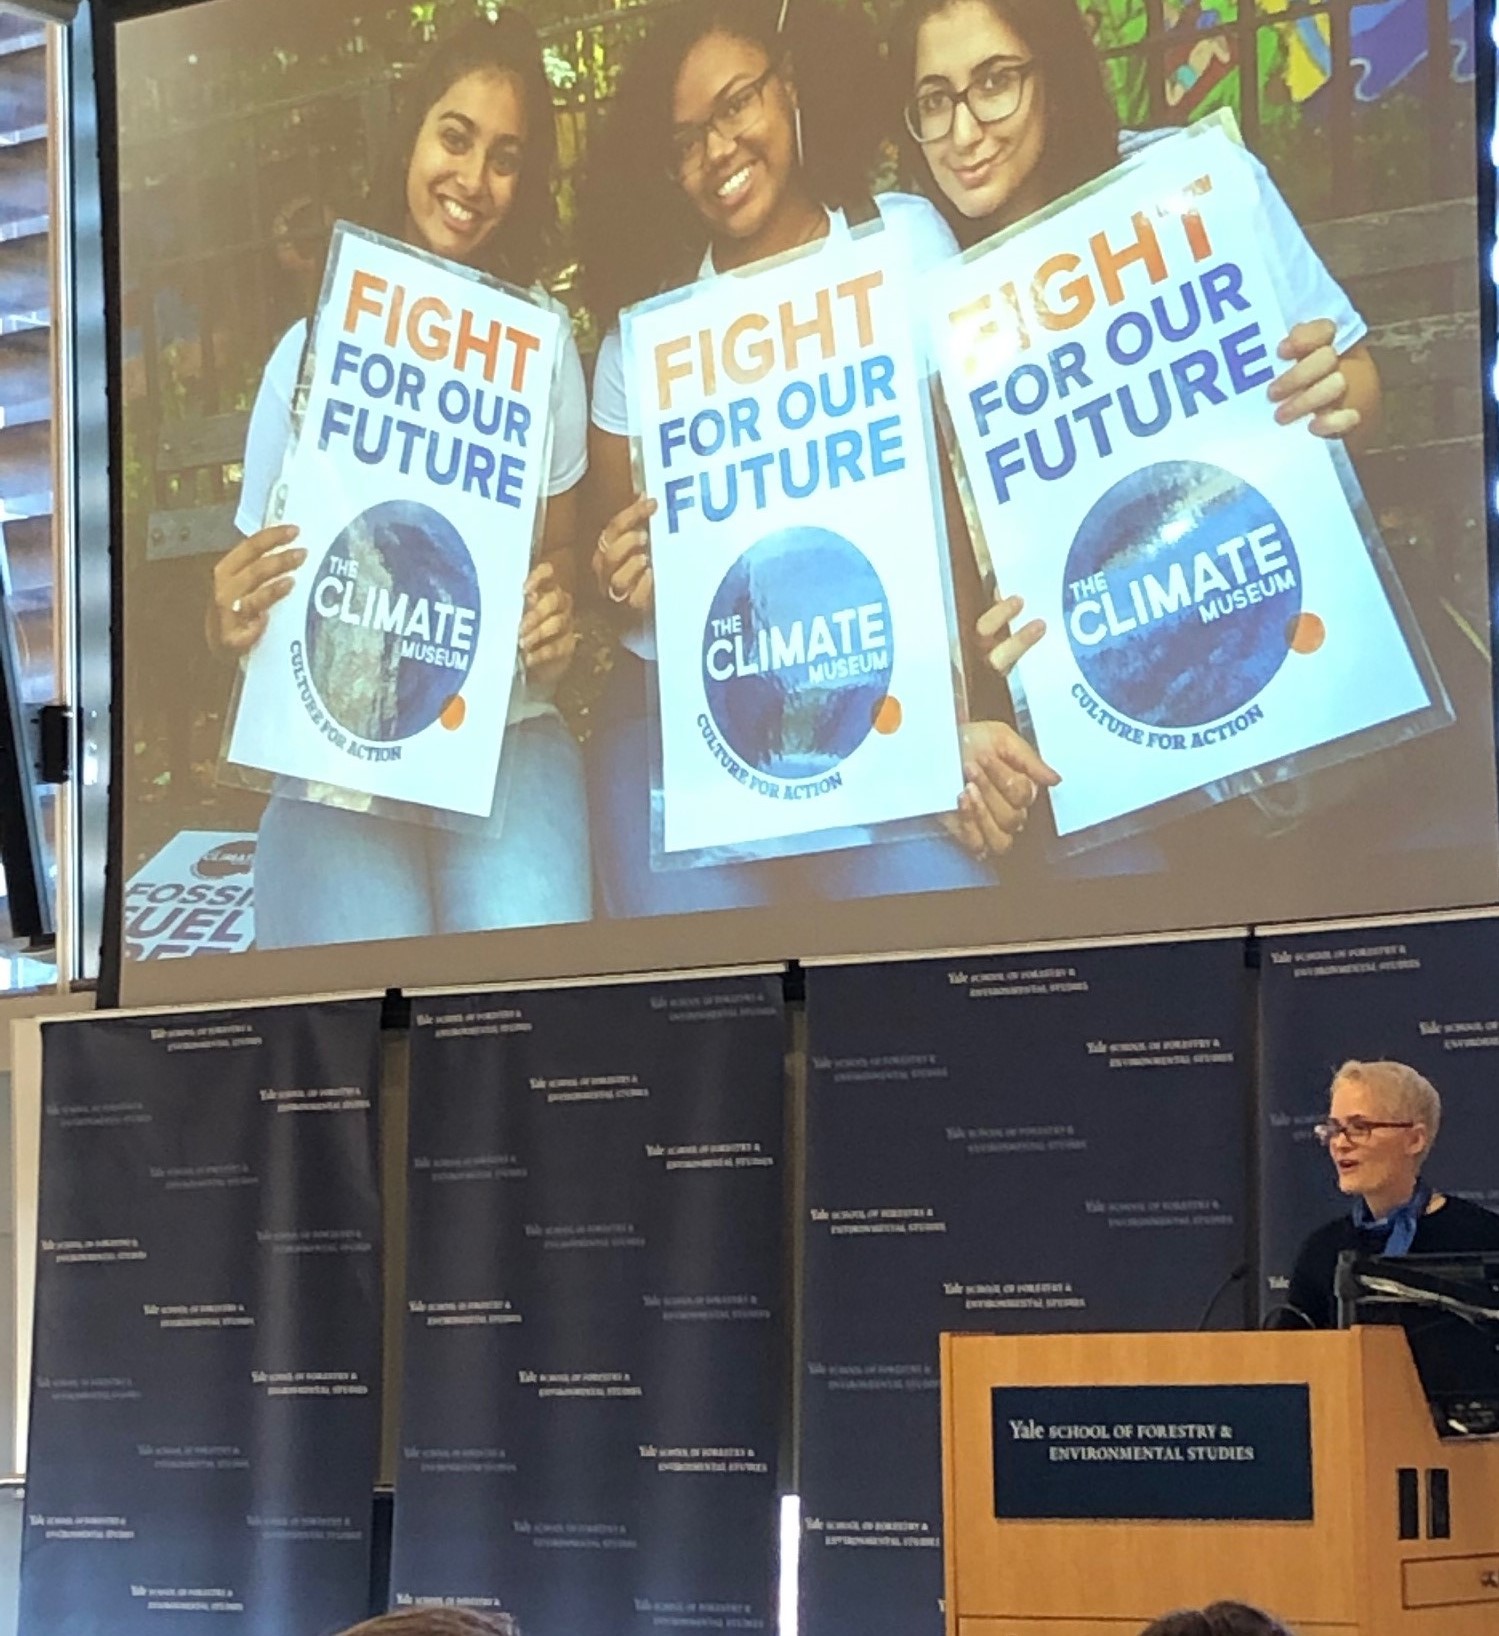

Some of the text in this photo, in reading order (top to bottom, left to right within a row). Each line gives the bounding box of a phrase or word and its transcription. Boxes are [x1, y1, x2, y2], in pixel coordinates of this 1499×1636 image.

[342, 269, 541, 393] FIGHT
[653, 269, 884, 410] FIGHT
[968, 262, 1251, 437] FOR OUR
[331, 342, 532, 447] FOR OUR
[658, 354, 898, 468] FOR OUR
[984, 321, 1275, 505] FUTURE
[318, 398, 526, 508] FUTURE
[665, 415, 906, 534] FUTURE
[328, 554, 359, 577] THE
[1068, 522, 1289, 647] CLIMATE
[1069, 570, 1107, 599] THE
[1198, 569, 1297, 626] MUSEUM
[313, 576, 477, 650] CLIMATE
[706, 602, 887, 683] CLIMATE
[711, 614, 742, 637] THE
[401, 639, 468, 671] MUSEUM
[808, 651, 888, 685] MUSEUM
[289, 639, 402, 762] CULTURE FOR ACTION
[1070, 681, 1265, 751] CULTURE FOR ACTION
[697, 712, 843, 800] CULTURE FOR ACTION
[948, 972, 968, 983] Yale
[1087, 1041, 1107, 1053] Yale
[811, 1209, 829, 1220] Yale
[943, 1283, 963, 1294] Yale
[1268, 1276, 1290, 1290] Yale
[1009, 1419, 1232, 1439] Yale SCHOOL OF FORESTRY &
[1050, 1446, 1255, 1461] ENVIRONMENTAL STUDIES
